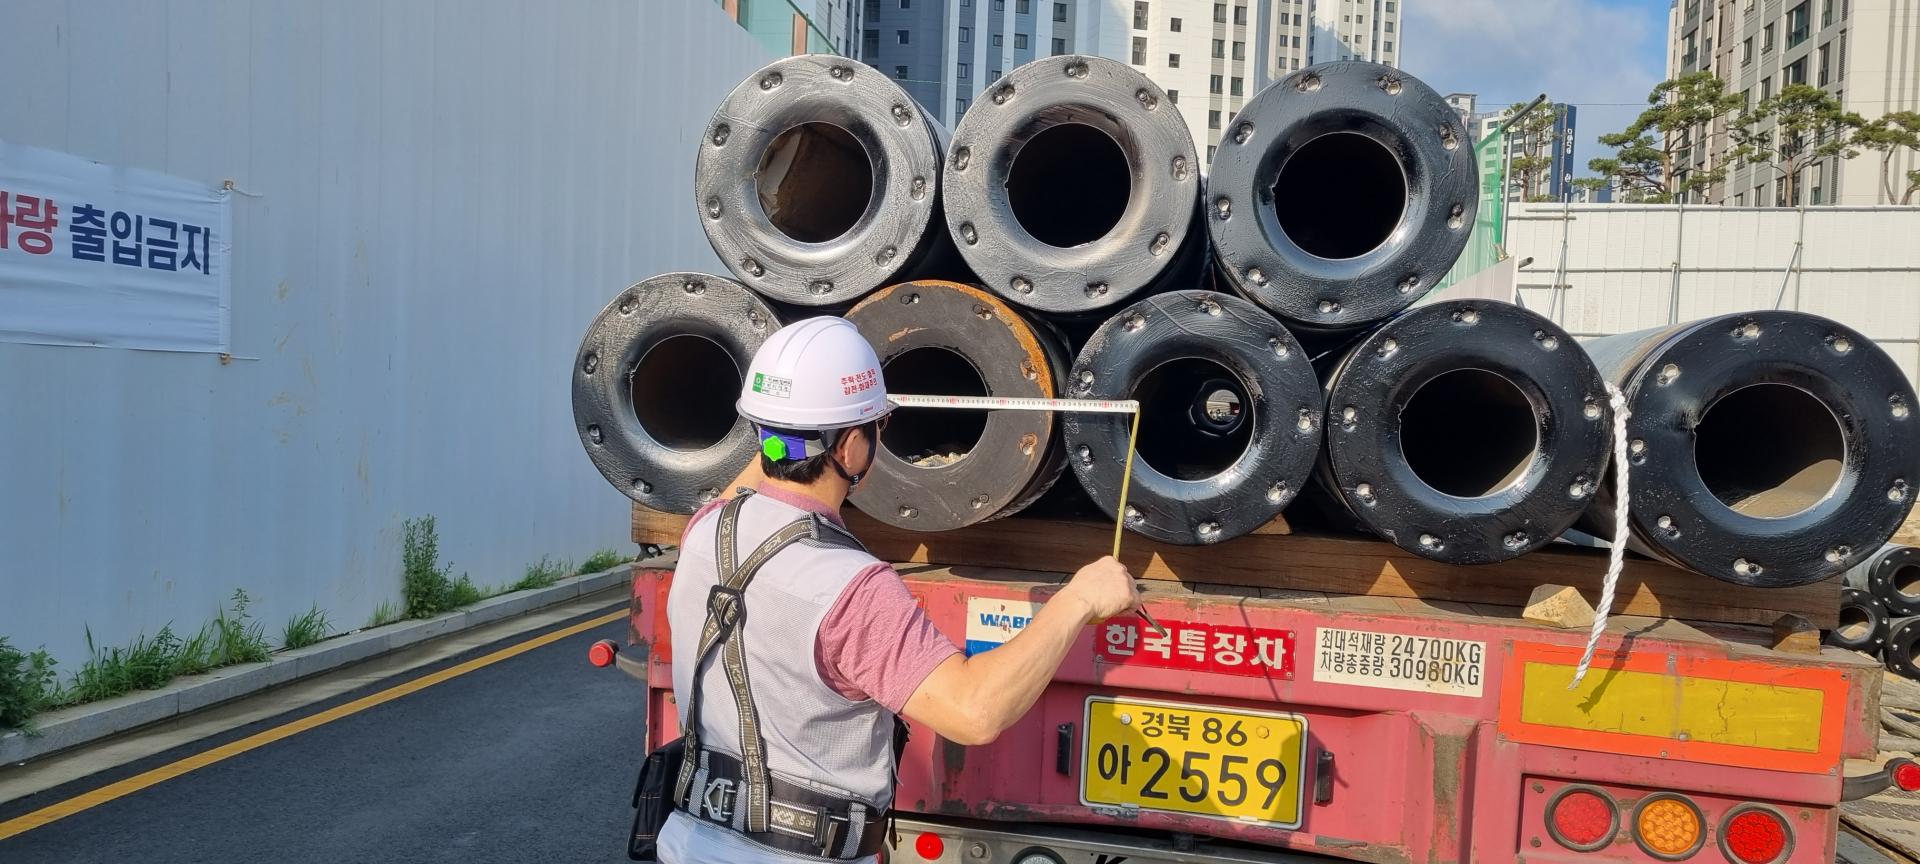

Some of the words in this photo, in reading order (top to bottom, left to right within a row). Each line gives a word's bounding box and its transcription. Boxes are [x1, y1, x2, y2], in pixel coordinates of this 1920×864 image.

[69, 203, 211, 275] 출입금지
[721, 516, 733, 535] K2
[1105, 623, 1287, 670] 한국특장차
[1391, 635, 1481, 664] 24700KG
[1320, 650, 1385, 677] 차량총중량
[1389, 657, 1479, 686] 30980KG
[1141, 711, 1191, 741] 경북
[1201, 717, 1248, 747] 86
